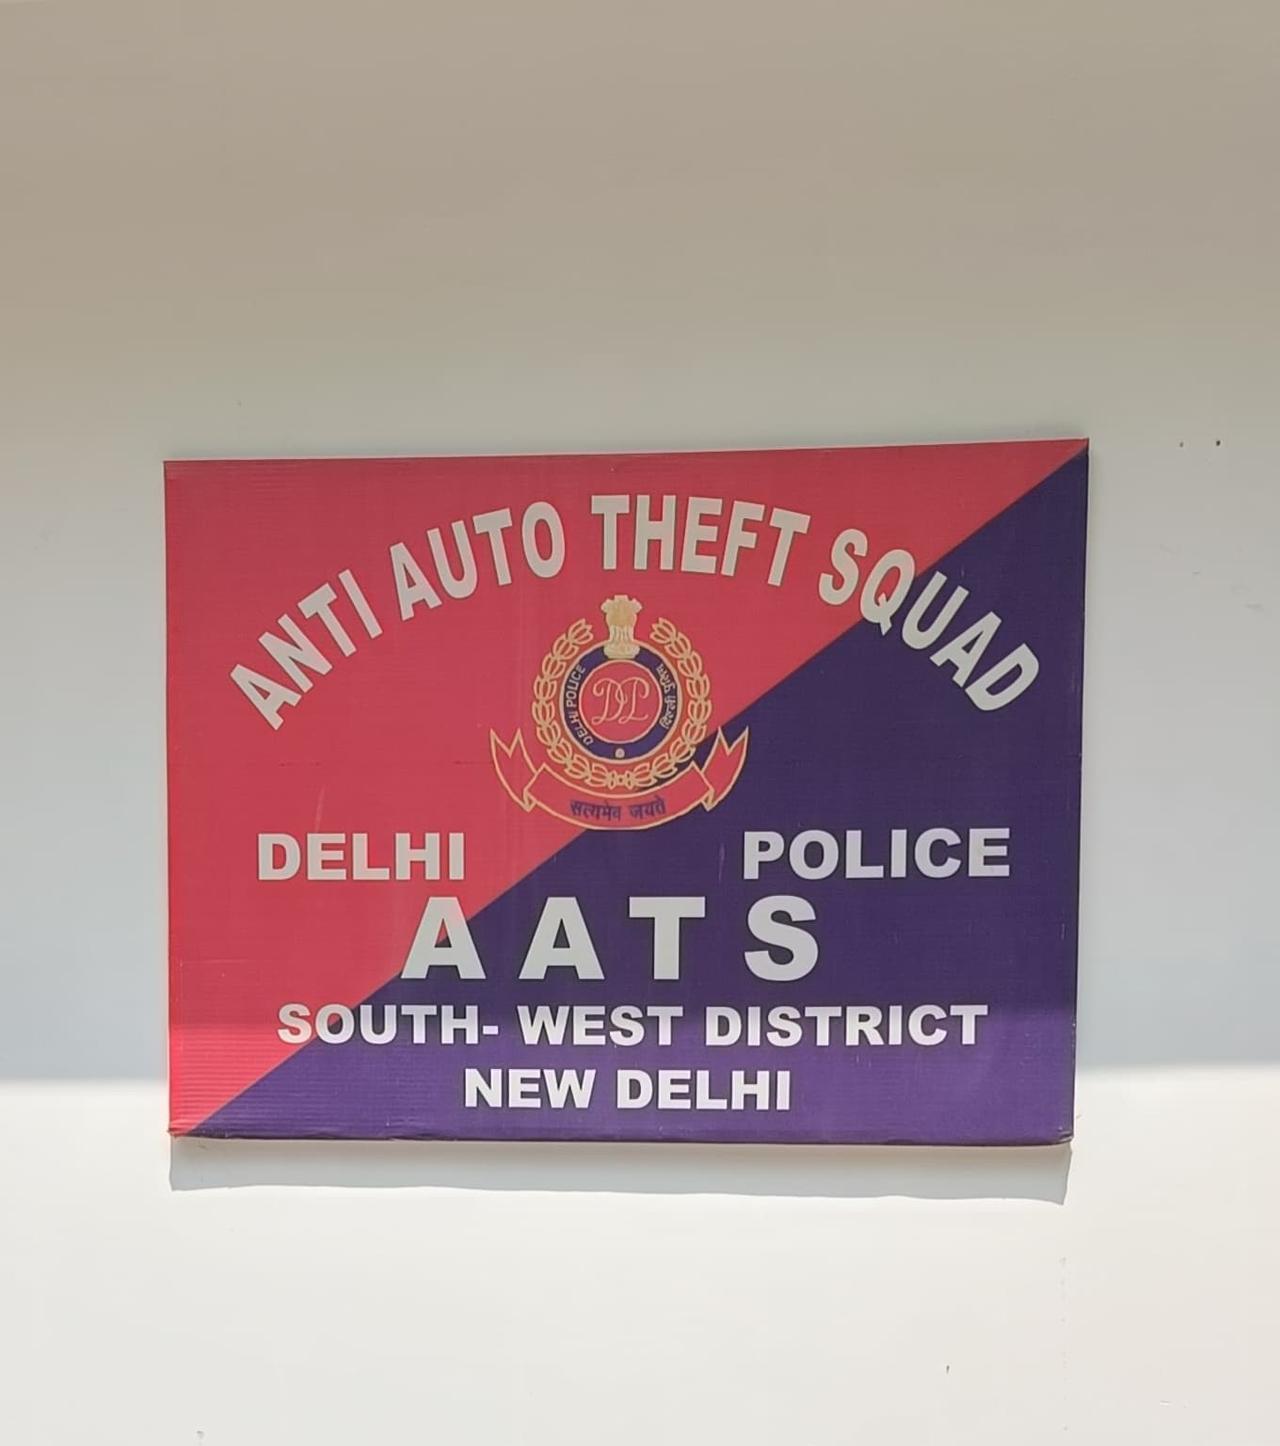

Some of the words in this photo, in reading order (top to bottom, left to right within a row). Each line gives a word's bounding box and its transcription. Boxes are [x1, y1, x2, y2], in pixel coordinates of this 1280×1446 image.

[230, 570, 382, 729] ANTI
[389, 501, 566, 621] AUTO
[590, 494, 811, 588] THEFT
[818, 528, 1040, 712] SQUAD
[565, 664, 586, 708] POLICE
[568, 710, 594, 745] DELHI
[570, 800, 622, 821] सत्यमेव
[627, 795, 666, 819] जयते
[257, 831, 465, 882] DELHI
[742, 826, 1011, 881] POLICE
[277, 1002, 500, 1046] SOUTH-
[516, 1004, 685, 1047] WEST
[704, 1003, 990, 1049] DISTRICT
[463, 1066, 598, 1110] NEW
[615, 1067, 792, 1112] DELHI
